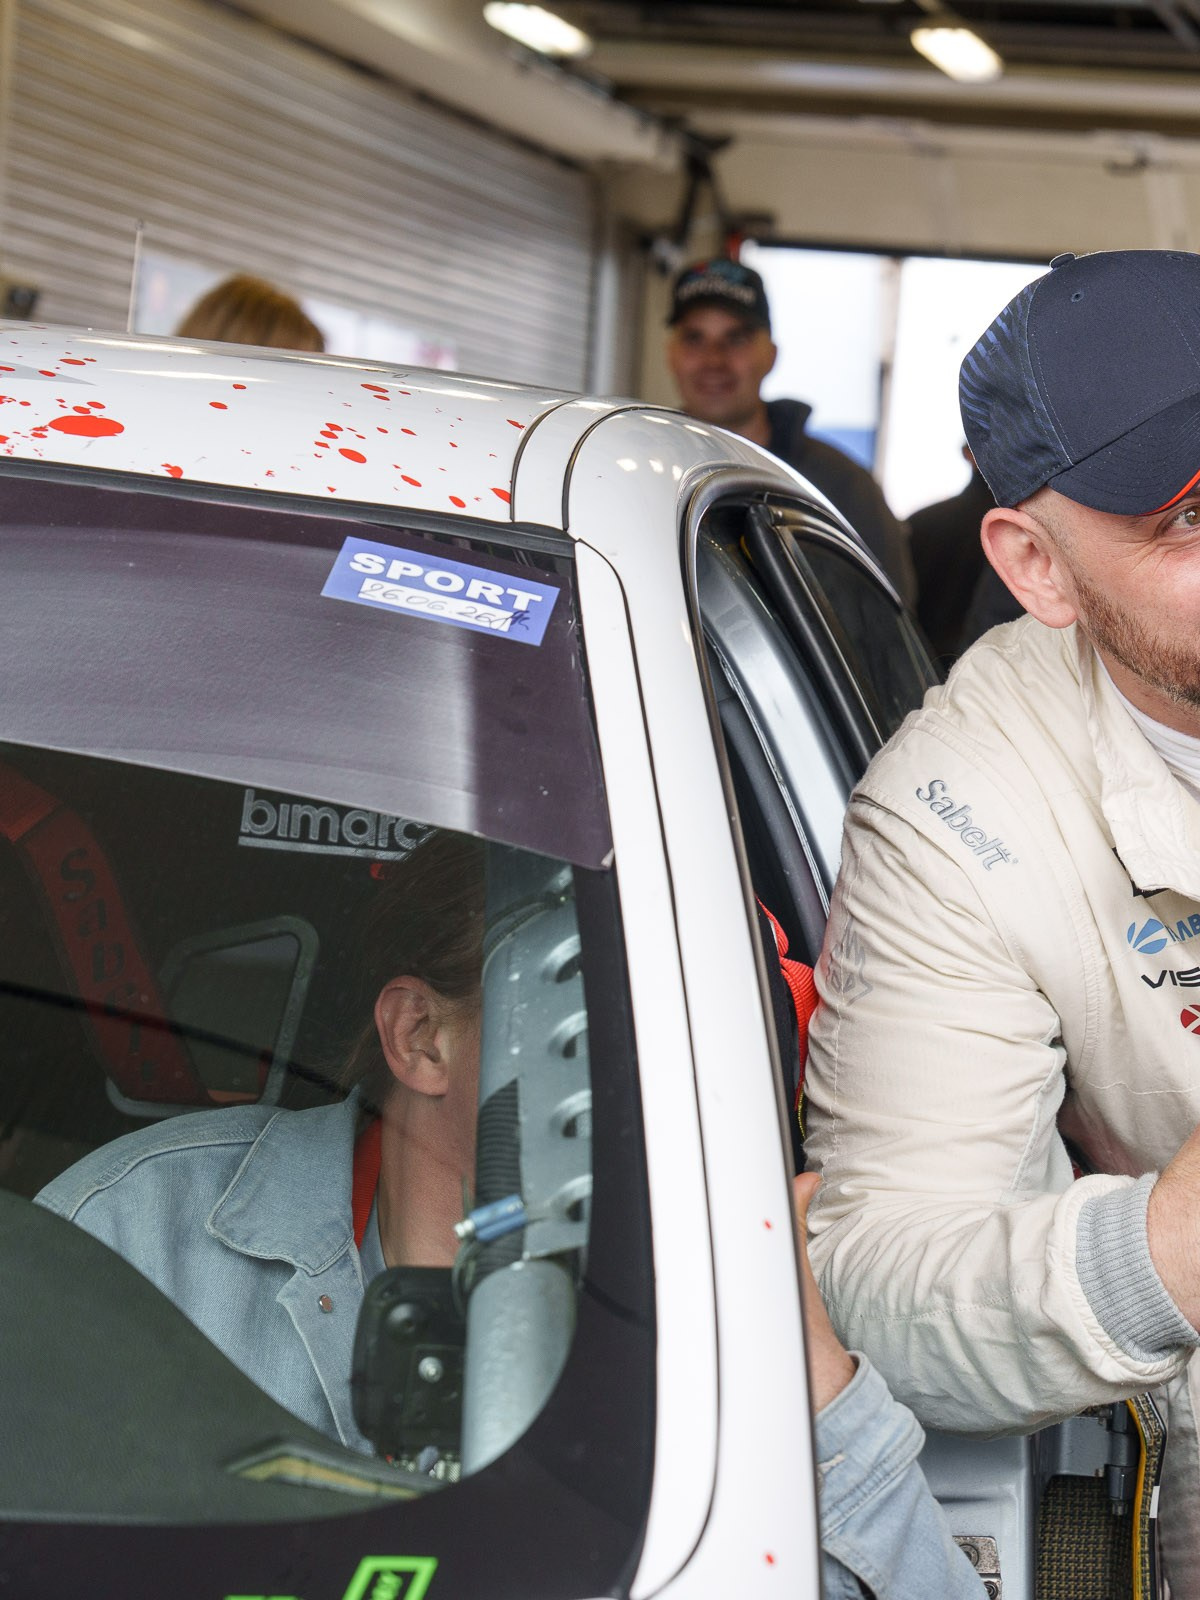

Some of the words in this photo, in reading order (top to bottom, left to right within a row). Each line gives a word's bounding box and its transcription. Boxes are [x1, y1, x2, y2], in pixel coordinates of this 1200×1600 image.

[349, 552, 543, 611] SPORT
[239, 788, 438, 850] bimarc
[915, 779, 1012, 871] Sabelt
